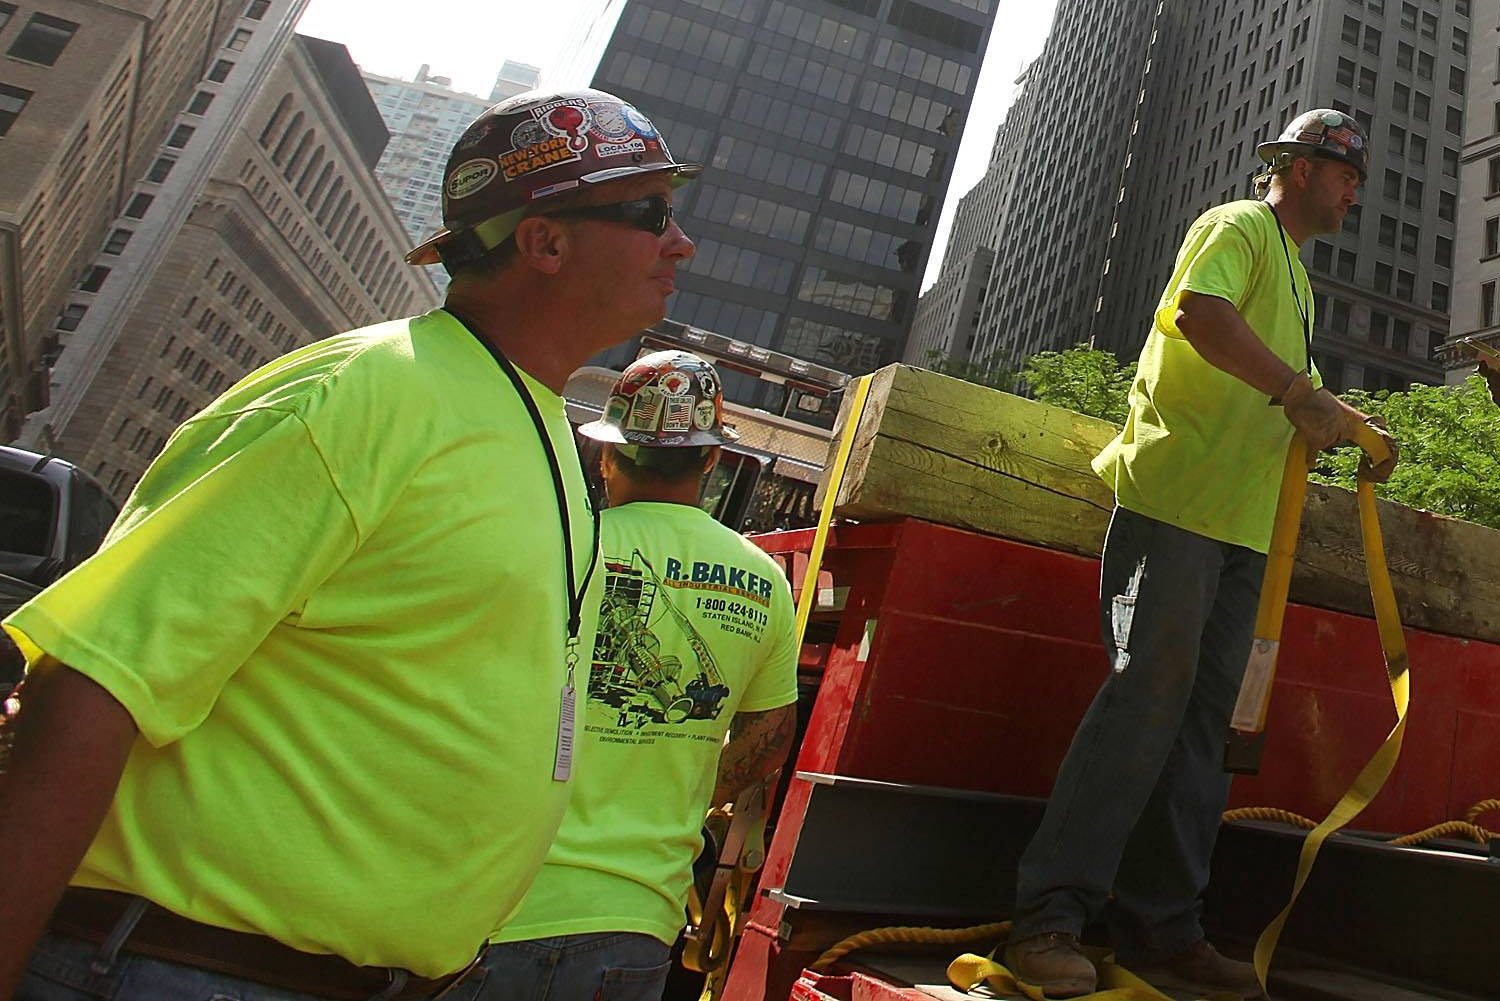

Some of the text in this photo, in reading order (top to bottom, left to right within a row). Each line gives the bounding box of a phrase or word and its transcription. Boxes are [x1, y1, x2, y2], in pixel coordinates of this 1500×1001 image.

[533, 98, 587, 117] RIGGERS
[500, 149, 528, 168] NEW
[530, 136, 568, 157] YORK
[599, 143, 627, 153] LOCAL
[506, 149, 571, 178] CRANE
[665, 557, 773, 600] R.BAKER
[696, 597, 768, 626] 1-800 424-8113
[702, 611, 731, 622] STATEN
[720, 623, 735, 633] RED
